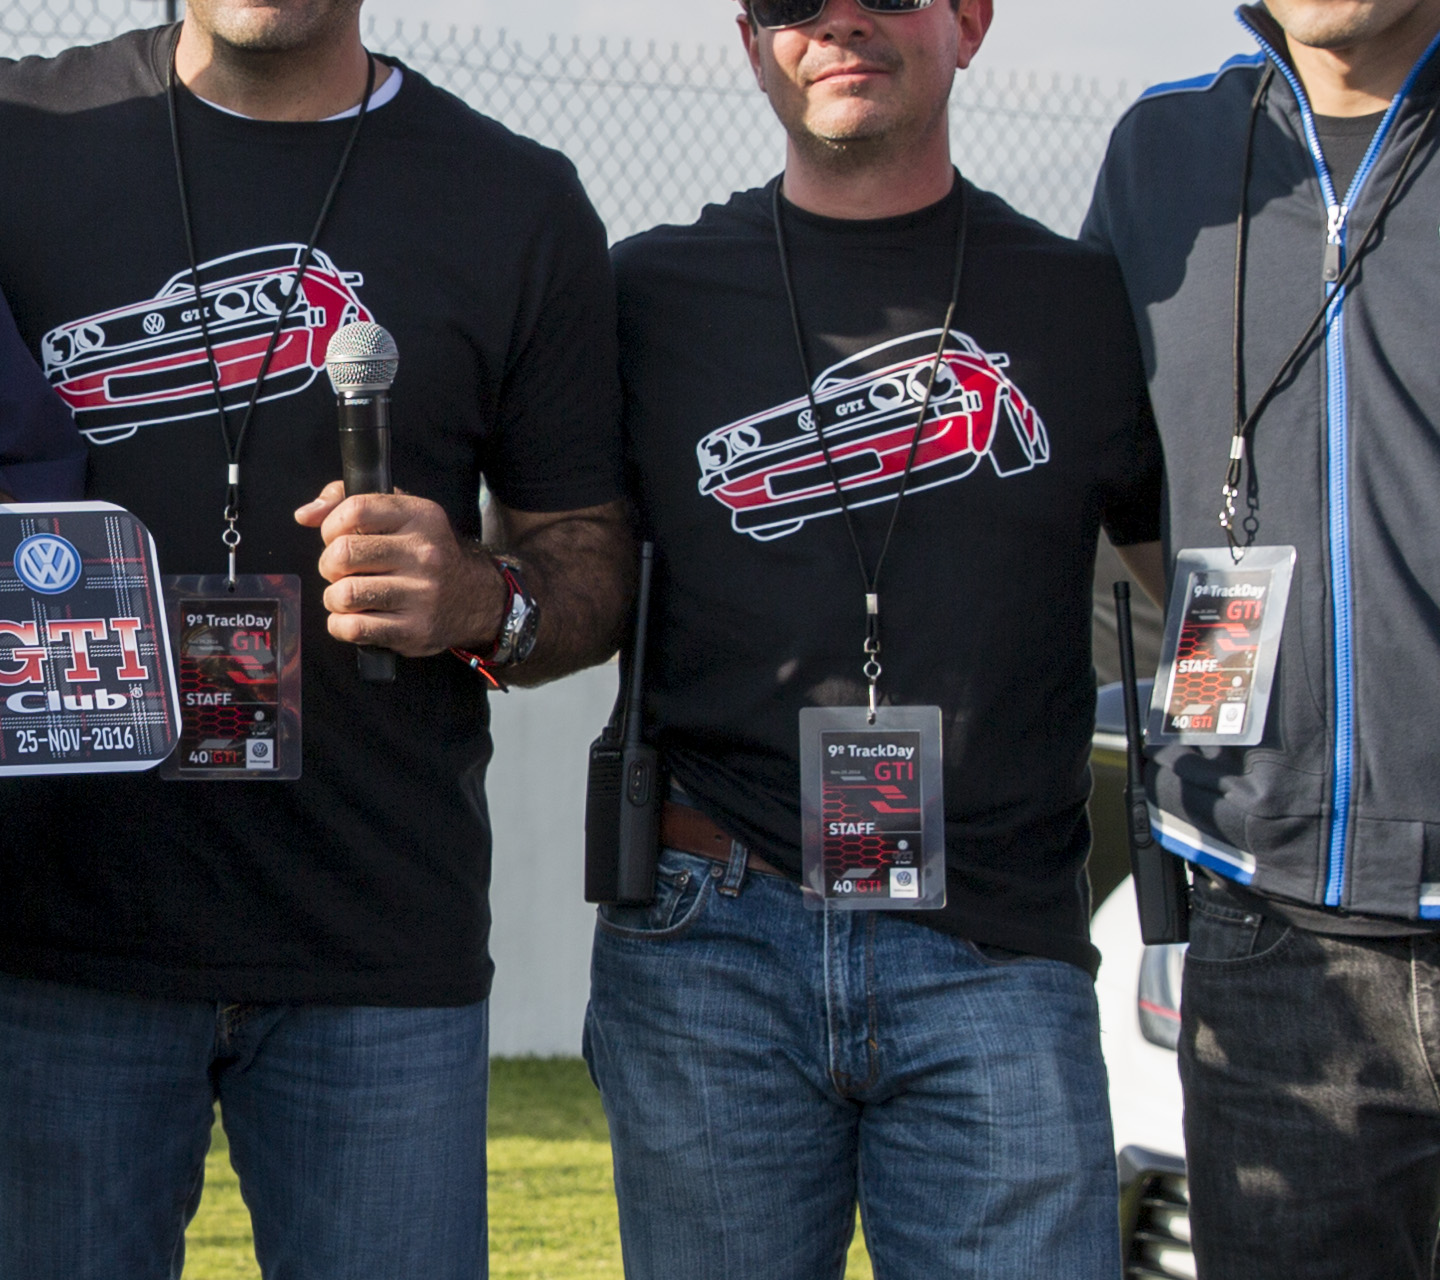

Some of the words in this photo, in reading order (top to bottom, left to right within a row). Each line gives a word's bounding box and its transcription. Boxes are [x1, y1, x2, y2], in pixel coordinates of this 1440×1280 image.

[835, 398, 866, 417] GTI
[1210, 584, 1266, 599] TrackDay
[1227, 600, 1261, 620] GTI
[206, 614, 272, 629] TrackDay
[232, 631, 271, 651] GTI
[1178, 659, 1218, 673] STAFF
[186, 693, 232, 706] STAFF
[16, 726, 134, 753] 25-NOV-2016
[213, 750, 237, 764] GTI
[828, 744, 845, 757] 9º
[847, 744, 915, 760] TrackDay
[874, 762, 913, 781] GTI
[829, 823, 876, 836] STAFF
[856, 879, 881, 893] GTI
